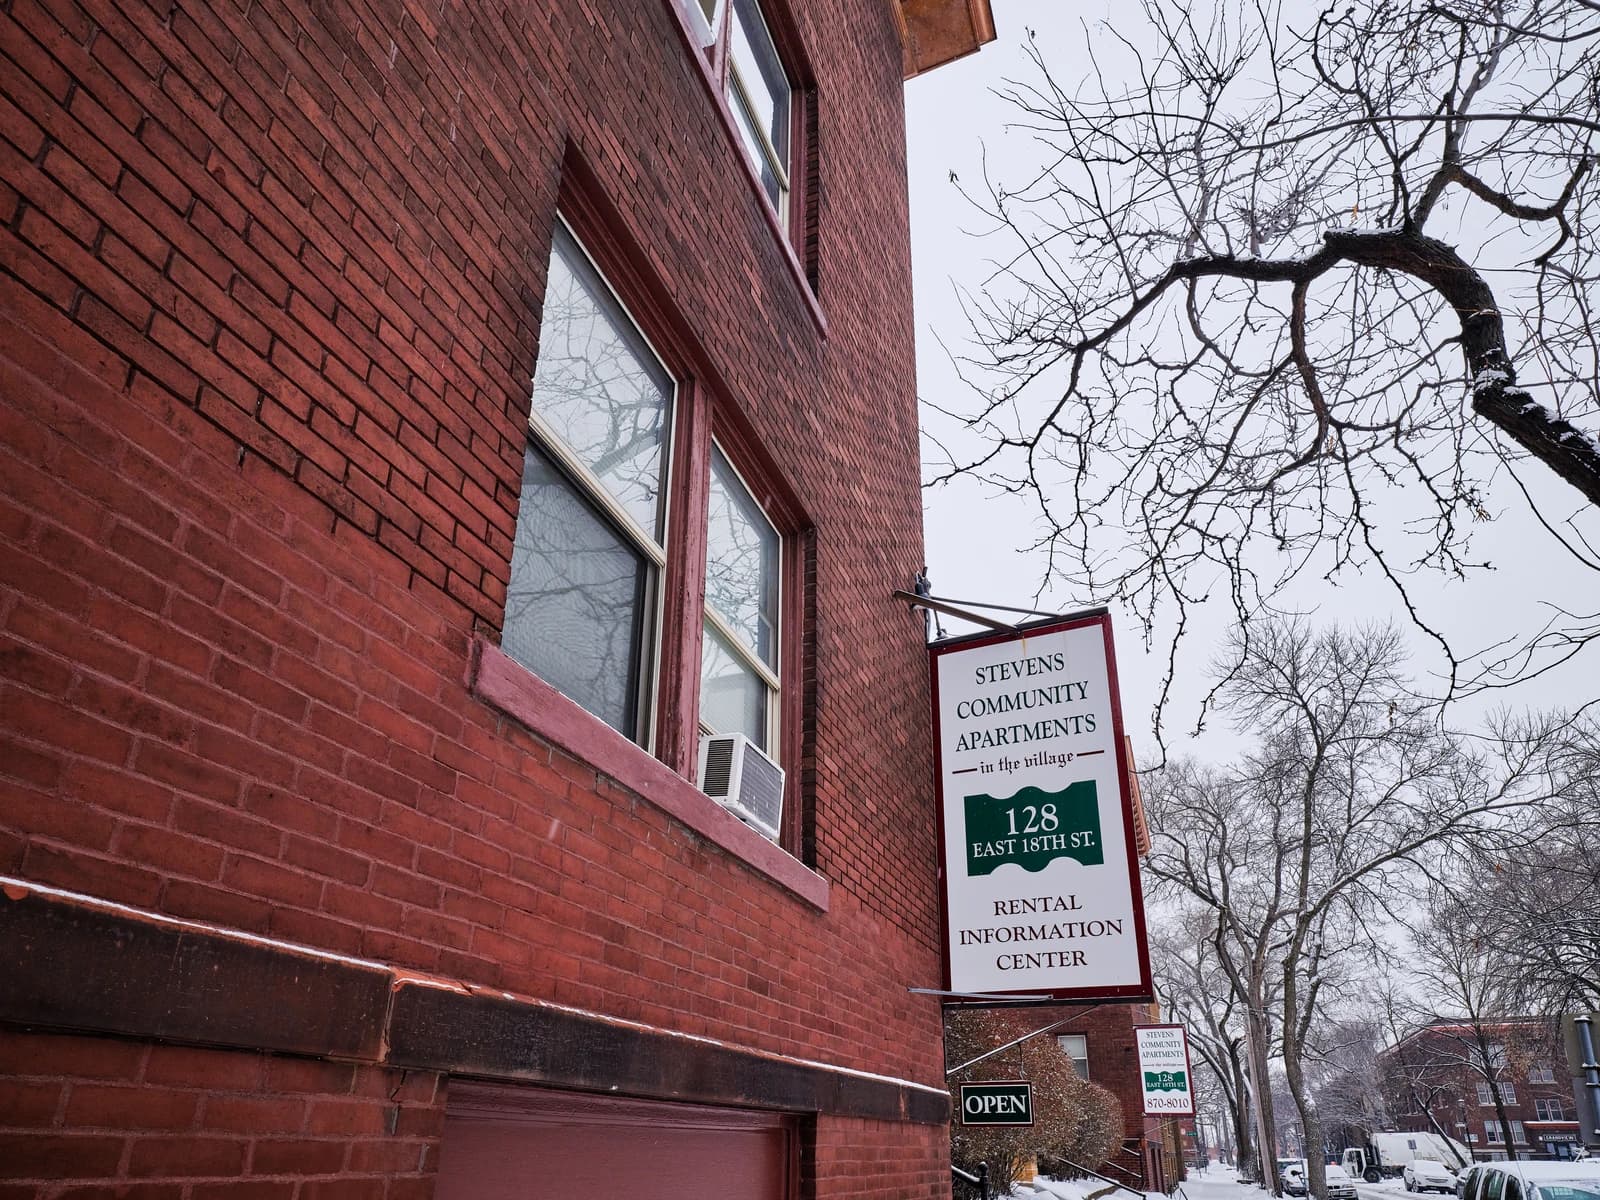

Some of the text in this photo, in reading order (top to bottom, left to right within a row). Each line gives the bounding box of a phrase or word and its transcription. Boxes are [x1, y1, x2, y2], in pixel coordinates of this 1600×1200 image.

[975, 653, 1065, 685] STEVENS
[957, 680, 1089, 719] COMMUNITY
[955, 713, 1097, 752] APARTMENTS
[980, 751, 1074, 775] in the village
[1005, 803, 1059, 836] 128
[972, 831, 1096, 858] EAST 18TH ST.
[993, 895, 1083, 916] RENTAL
[959, 919, 1123, 945] INFORMATION
[996, 950, 1088, 971] CENTER
[1140, 1040, 1182, 1049] COMMUNITY
[1146, 1031, 1175, 1039] STEVENS
[1141, 1050, 1184, 1058] APARTMENTS
[1157, 1073, 1174, 1082] 128
[965, 1094, 1027, 1114] OPEN
[1147, 1098, 1189, 1108] 870-8010
